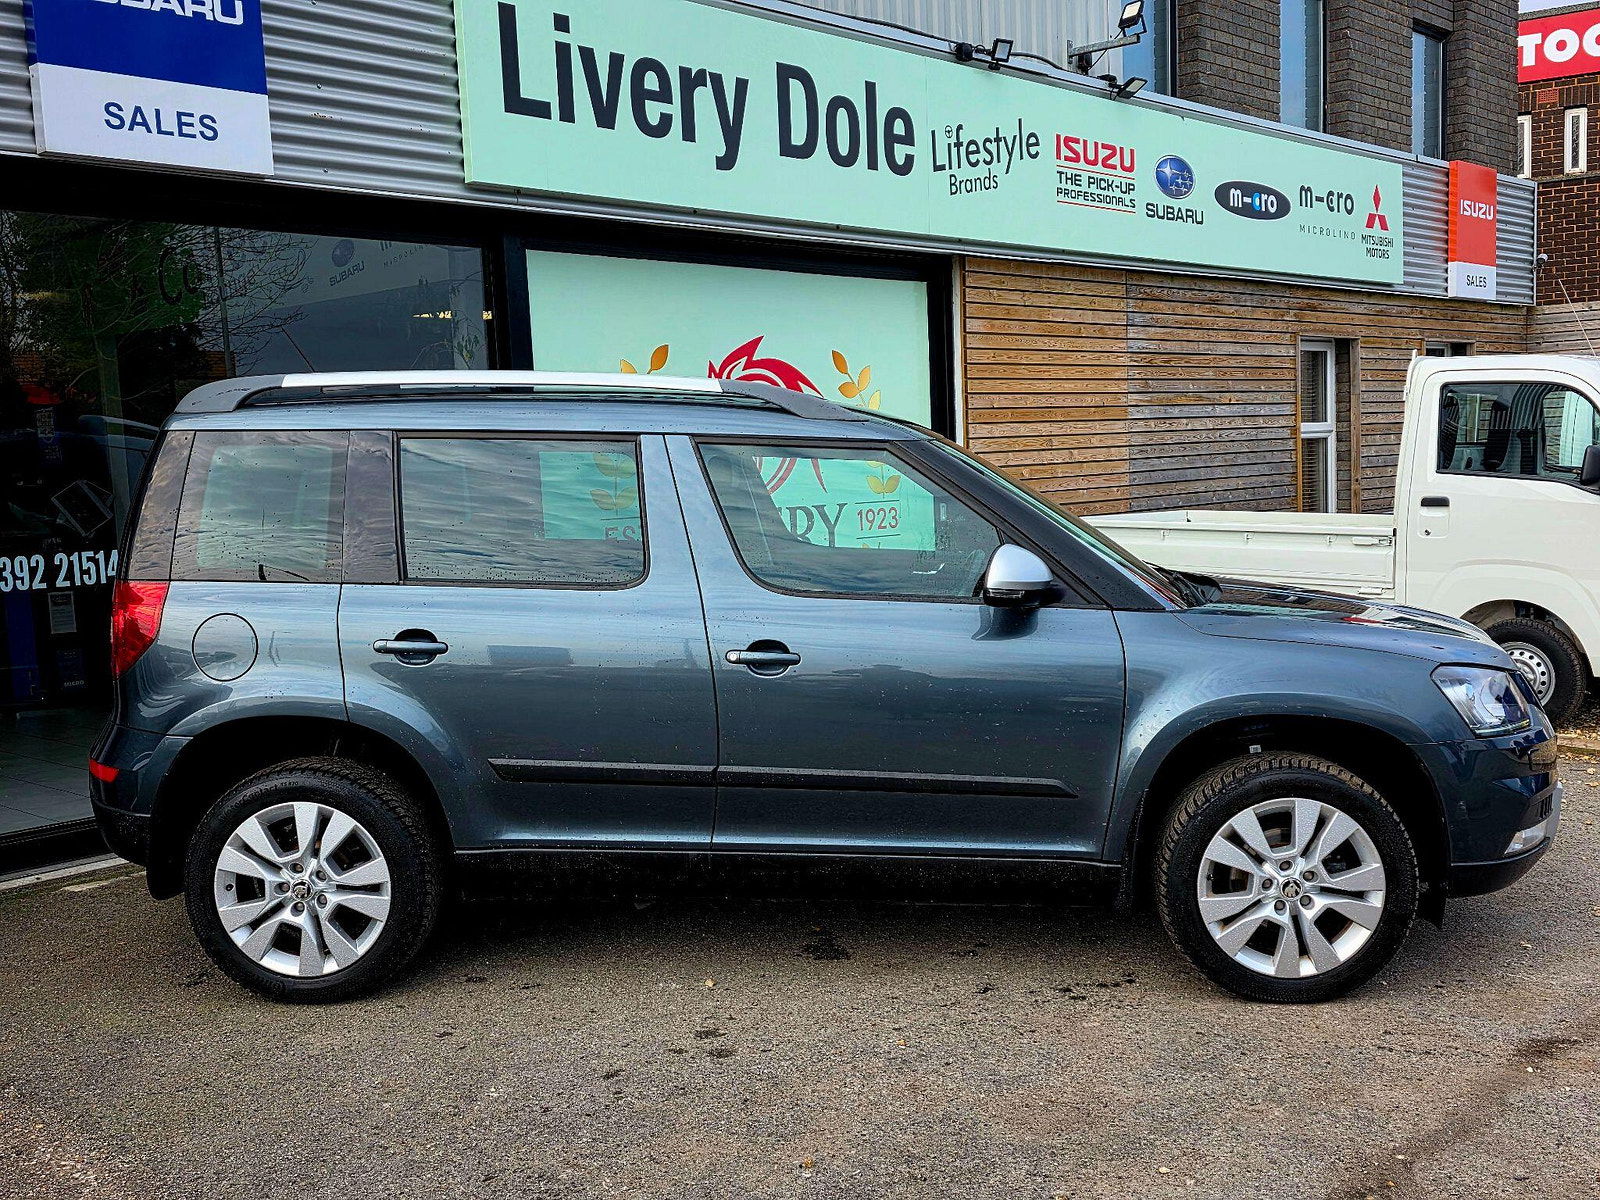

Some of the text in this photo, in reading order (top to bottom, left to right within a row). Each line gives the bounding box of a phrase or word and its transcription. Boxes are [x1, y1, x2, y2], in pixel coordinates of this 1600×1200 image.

[498, 1, 916, 177] Livery Dole
[104, 102, 219, 142] SALES
[931, 118, 1041, 174] Lifestyle
[1055, 133, 1136, 173] ISUZU
[950, 168, 999, 196] Brands
[1056, 170, 1136, 195] THE PICK-UP
[1056, 187, 1136, 208] PROFESSIONALS
[1460, 199, 1494, 220] ISUZU
[1145, 202, 1204, 225] SUBARU
[1299, 224, 1356, 240] MICROLINO
[1361, 234, 1394, 248] MITSUBISHI
[1365, 247, 1390, 260] MOTORS
[329, 260, 365, 287] SUBARU
[1466, 274, 1488, 288] SALES
[857, 506, 899, 531] 1923
